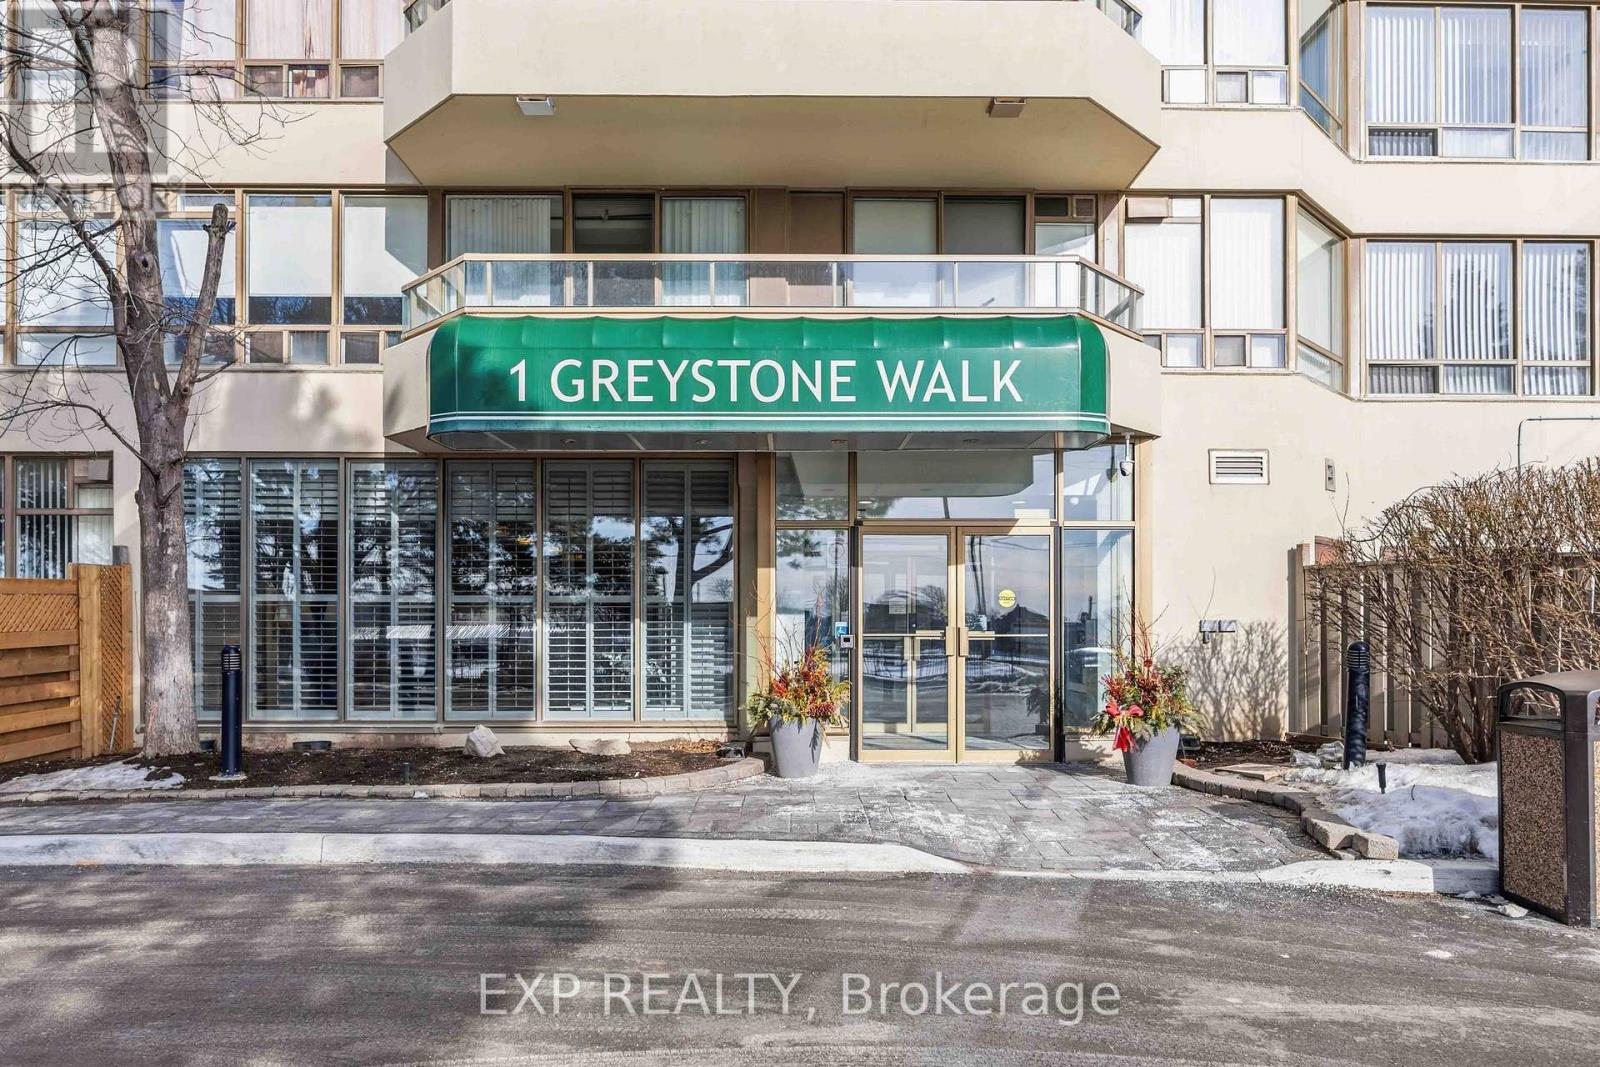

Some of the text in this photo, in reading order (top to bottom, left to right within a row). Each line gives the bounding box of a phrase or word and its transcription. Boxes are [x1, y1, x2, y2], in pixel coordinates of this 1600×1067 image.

[509, 358, 1024, 403] 1 GREYSTONE WALK
